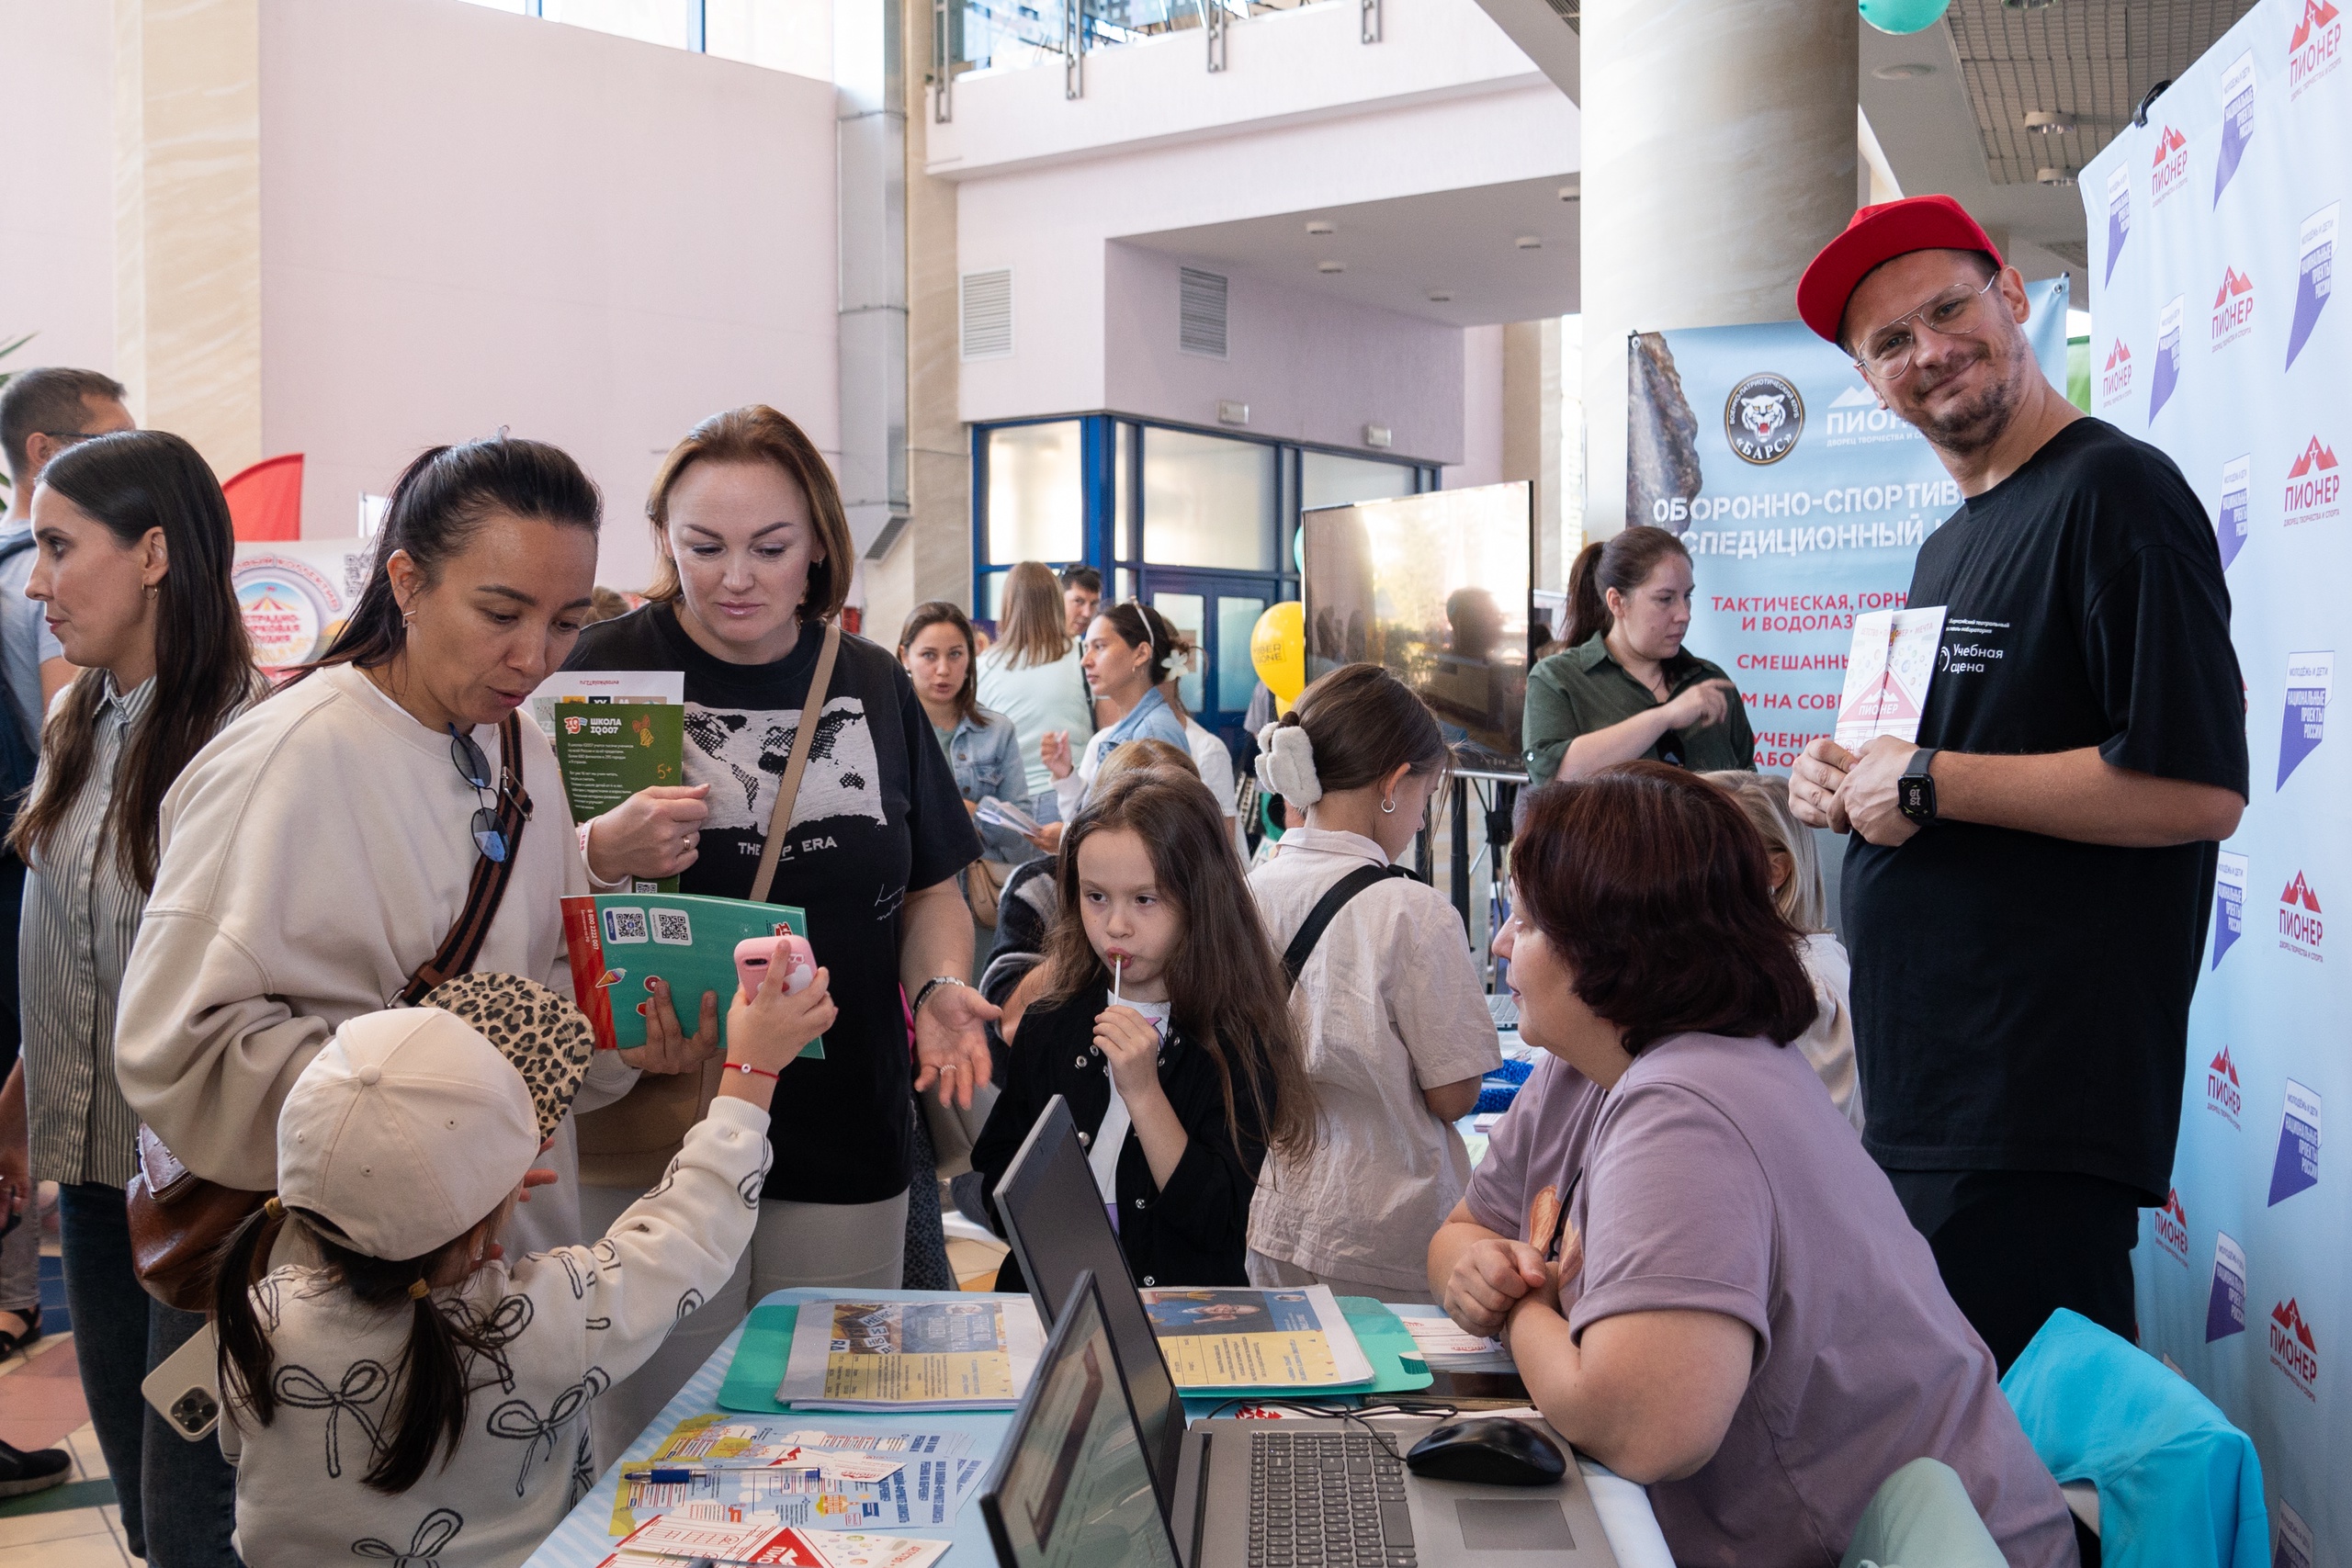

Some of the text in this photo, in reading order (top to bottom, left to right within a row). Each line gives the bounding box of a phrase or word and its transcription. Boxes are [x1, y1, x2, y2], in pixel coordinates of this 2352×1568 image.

[2290, 23, 2341, 87] ПИОНЕР
[2153, 150, 2187, 196] ПИОНЕР
[2212, 297, 2253, 340] ПИОНЕР
[2103, 364, 2132, 397] ПИОНЕР
[1736, 434, 1792, 459] «БАРС»
[1826, 438, 1856, 447] ДВОРЕЦ
[1859, 433, 1905, 444] ТВОРЧЕСТВА
[2284, 475, 2339, 513] ПИОНЕР
[1678, 513, 1923, 558] СПЕДИЦИОННЫЙ
[1712, 593, 1854, 612] ТАКТИЧЕСКАЯ,
[1742, 615, 1854, 633] И ВОДОЛАЗ
[1953, 644, 2003, 659] Учебная
[1951, 662, 1984, 673] сцена
[2289, 667, 2312, 676] МОЛОДЁЖЬ
[2316, 667, 2328, 677] ДЕТИ
[1764, 694, 1792, 709] НА
[2287, 691, 2325, 707] НАЦИОНАЛЬНЫЕ
[1858, 703, 1899, 716] ПИОНЕР
[2301, 707, 2324, 722] ПРОЕКТЫ
[2304, 723, 2323, 739] РОССИИ
[1753, 751, 1799, 766] АБО
[657, 763, 673, 779] 5+
[738, 841, 762, 855] THE
[801, 836, 838, 852] ERA
[2279, 908, 2324, 946] ПИОНЕР
[2208, 1074, 2241, 1117] ПИОНЕР
[2155, 1211, 2188, 1256] ПИОНЕР
[2270, 1323, 2317, 1384] ПИОНЕР
